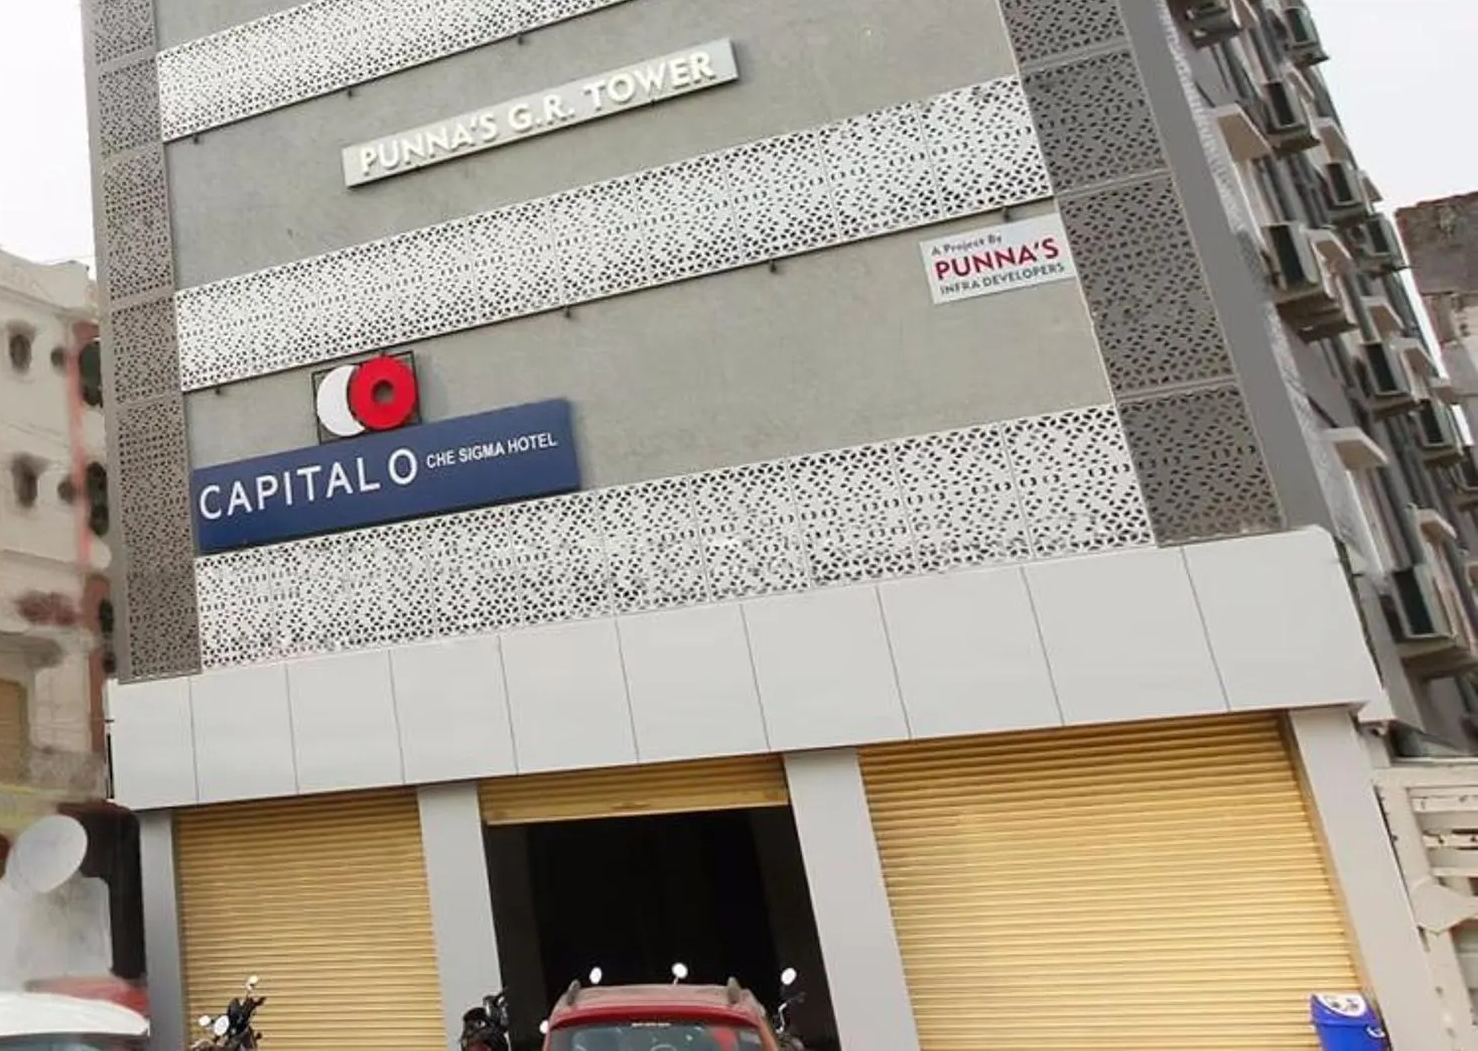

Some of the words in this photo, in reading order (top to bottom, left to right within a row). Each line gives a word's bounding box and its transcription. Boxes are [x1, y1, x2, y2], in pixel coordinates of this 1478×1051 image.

[359, 112, 497, 175] PUNNA'S
[507, 94, 576, 132] G.R.
[584, 50, 717, 111] TOWER
[931, 246, 941, 256] A
[935, 237, 1059, 280] PUNNA'S
[940, 280, 980, 295] INFRA
[982, 262, 1066, 287] DEVELOPERS
[199, 456, 381, 520] CAPITAL
[388, 448, 419, 486] O
[426, 452, 456, 469] CHE
[458, 440, 504, 463] SIGMA
[507, 431, 558, 454] HOTEL
